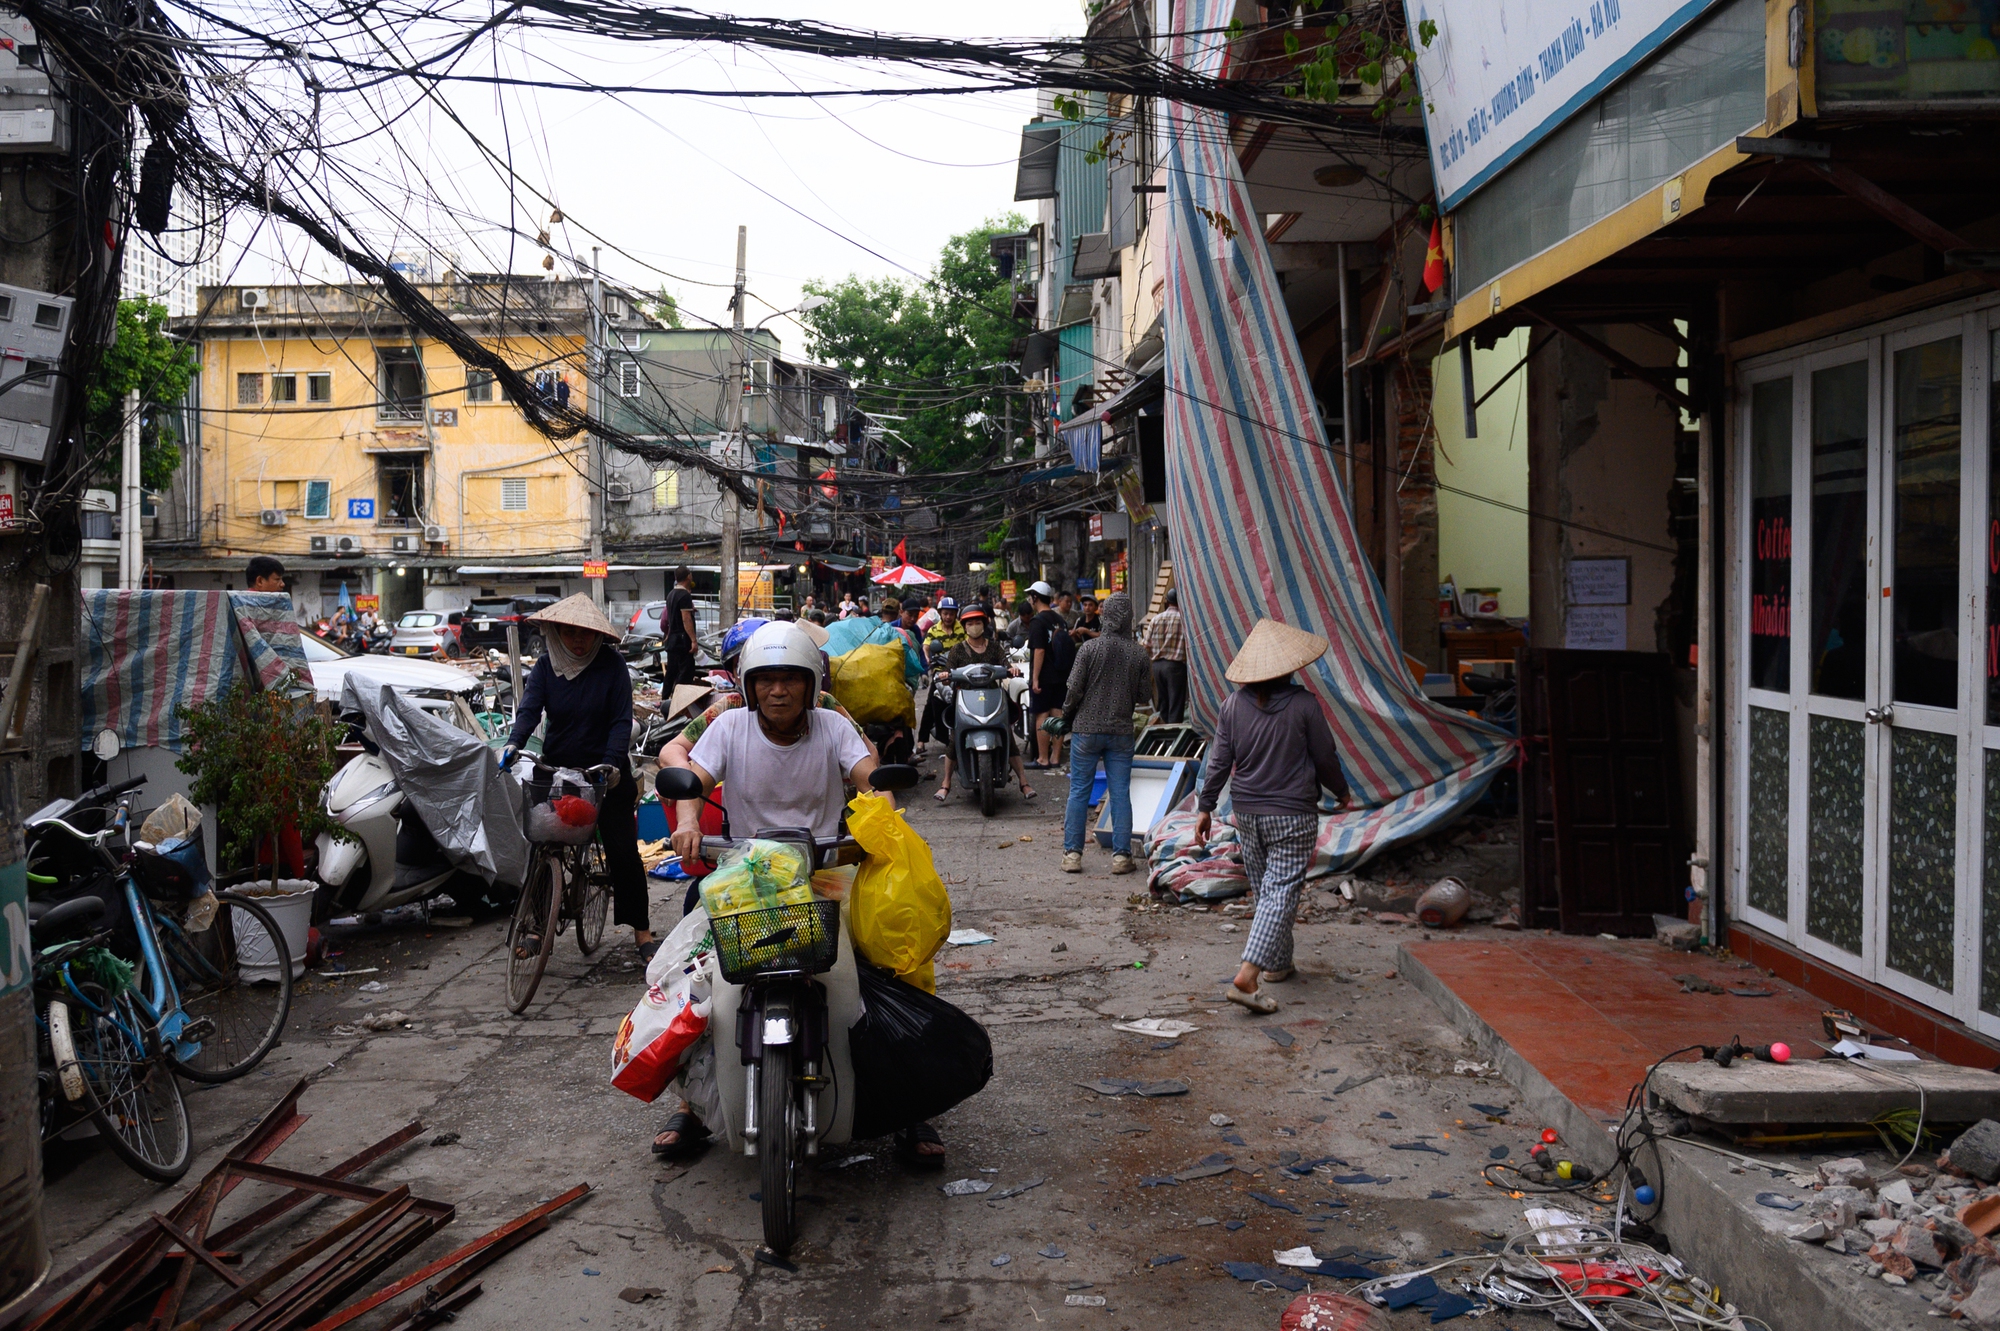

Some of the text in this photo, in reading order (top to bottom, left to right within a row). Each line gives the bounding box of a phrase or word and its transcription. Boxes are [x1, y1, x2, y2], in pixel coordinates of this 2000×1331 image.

[1538, 36, 1564, 84] THANH
[433, 410, 454, 424] F3
[352, 501, 371, 517] F3
